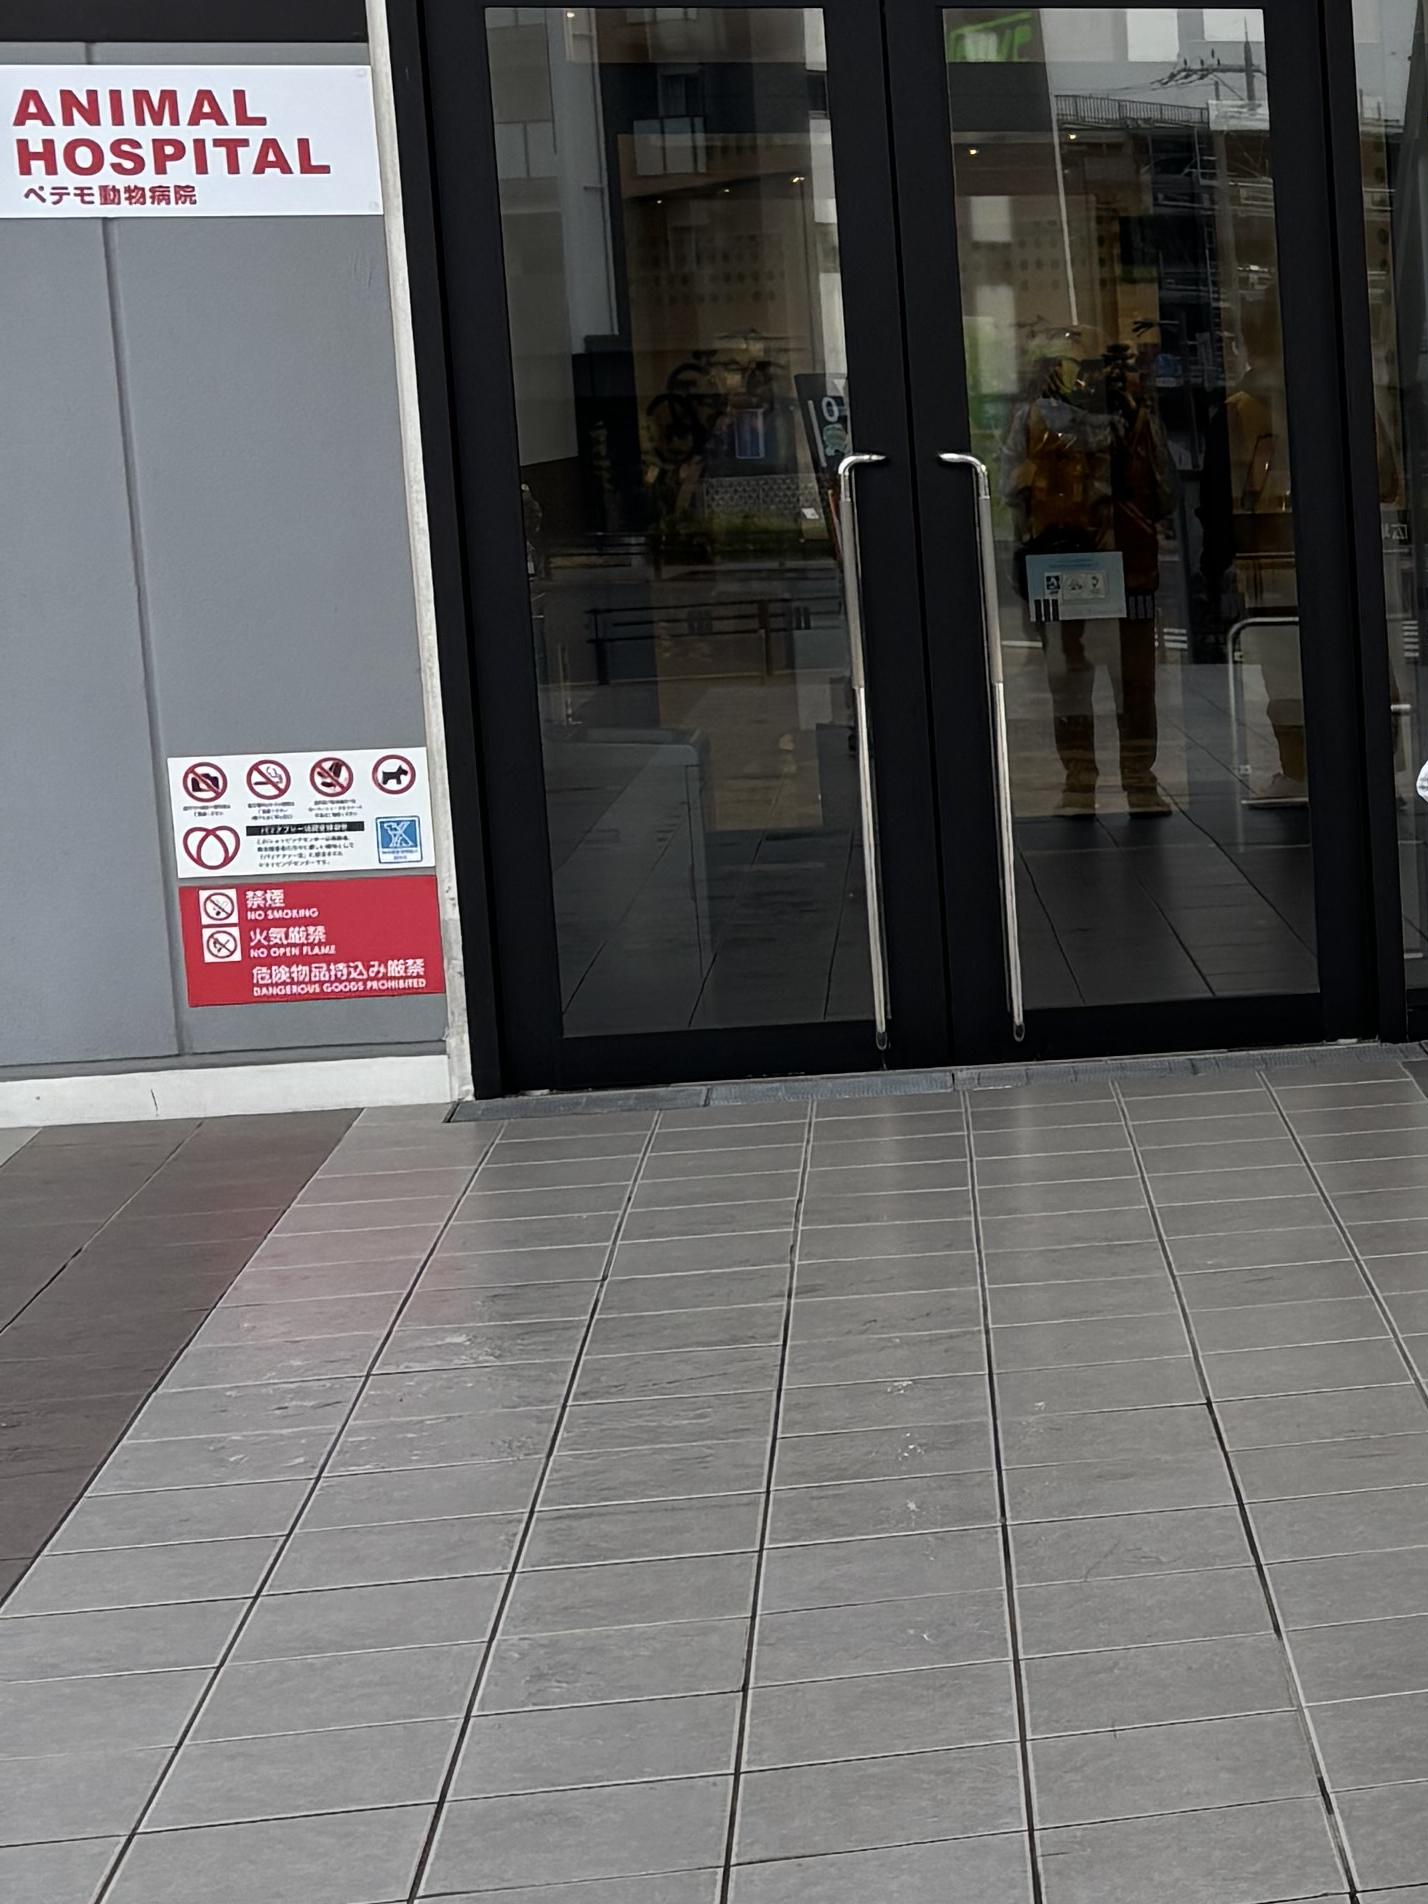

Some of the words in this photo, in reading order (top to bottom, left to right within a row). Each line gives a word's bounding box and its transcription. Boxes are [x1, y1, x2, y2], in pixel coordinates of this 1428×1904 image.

[12, 88, 268, 127] ANIMAL
[15, 137, 332, 176] HOSPITAL
[23, 184, 198, 206] ペテモ動物病院
[245, 889, 286, 909] 禁煙
[247, 910, 265, 921] NO
[267, 907, 320, 920] SMOKING
[250, 925, 328, 947] 火気厳禁
[250, 947, 268, 958] NO
[271, 946, 300, 958] OPEN
[302, 944, 337, 956] FLAME
[252, 958, 426, 986] 危険物品持込み厳禁
[253, 982, 321, 997] DANGEROUS
[322, 980, 365, 993] GOODS
[366, 977, 427, 992] PROHIBITED
